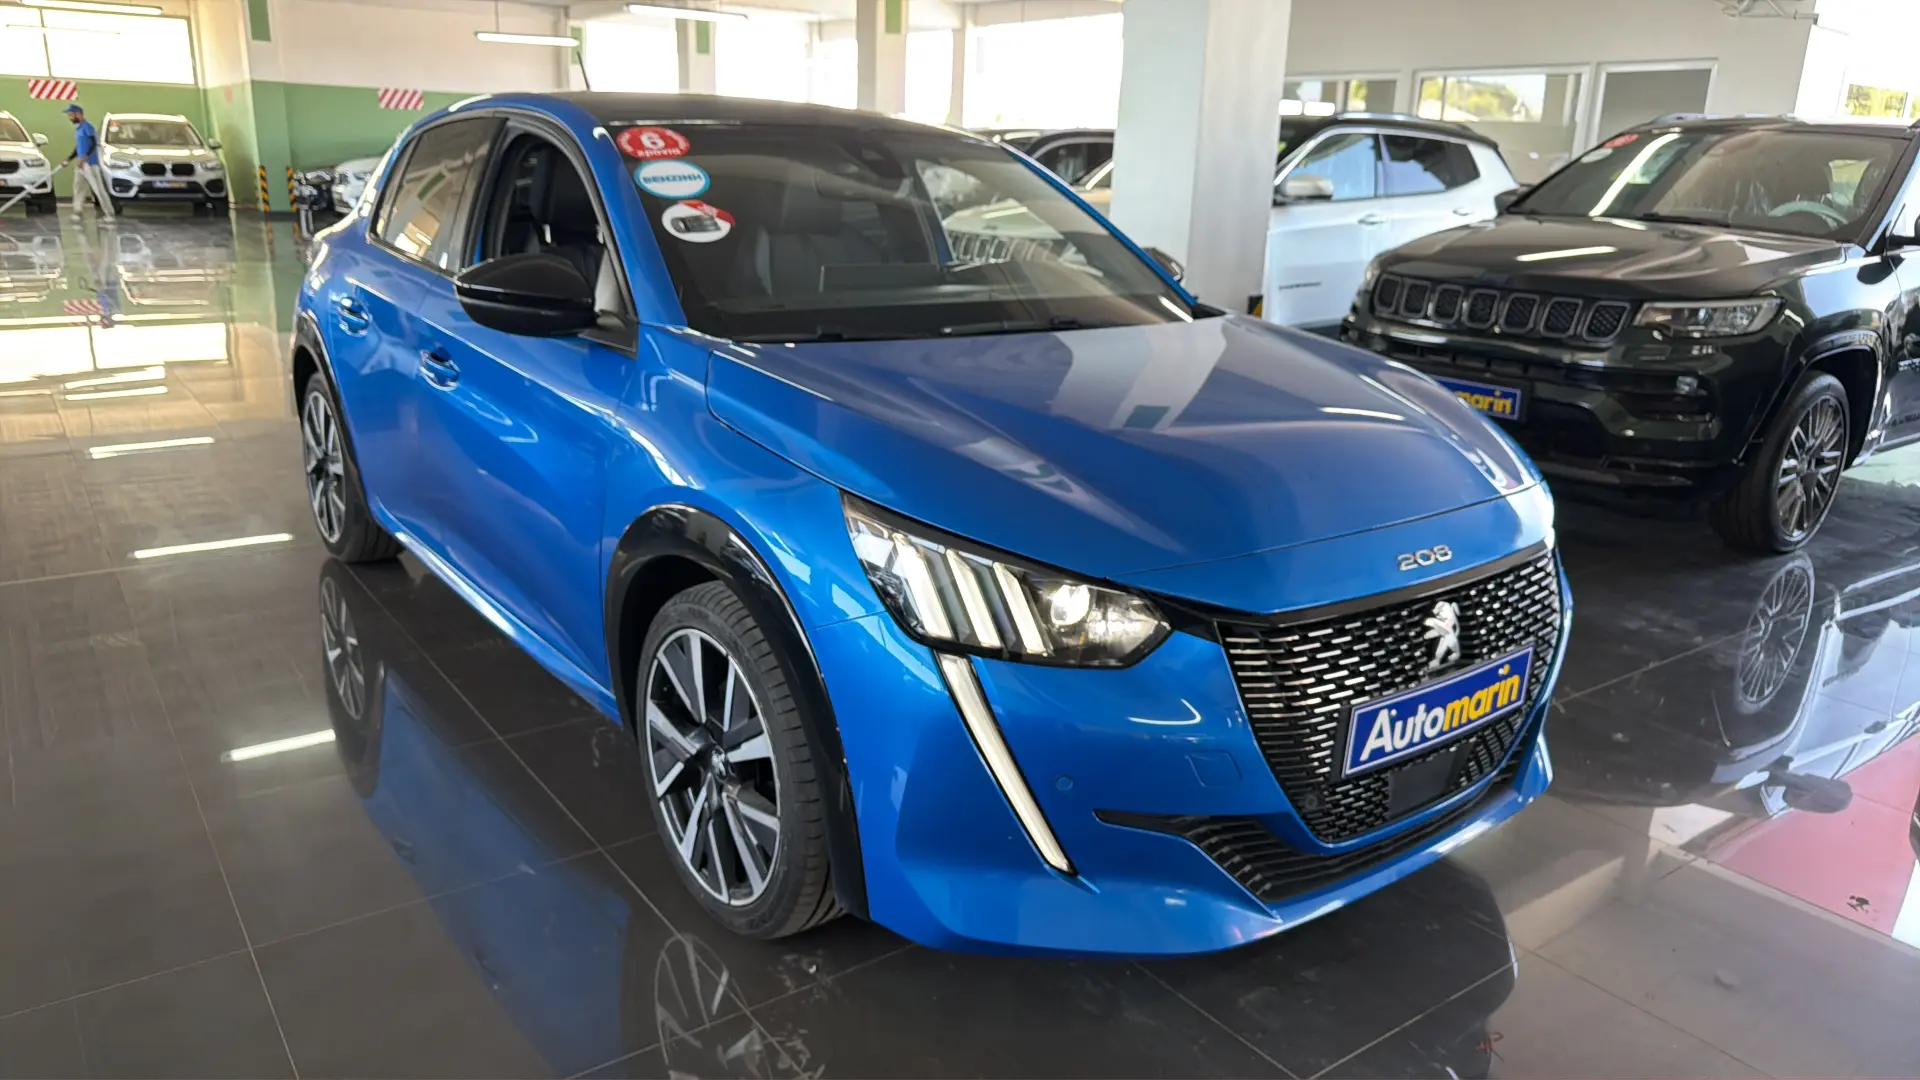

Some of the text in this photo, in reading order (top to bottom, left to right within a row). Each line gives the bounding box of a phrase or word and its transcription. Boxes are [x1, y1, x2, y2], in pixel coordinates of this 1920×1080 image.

[640, 131, 666, 150] 6
[1396, 543, 1453, 572] 208
[1359, 663, 1521, 762] Automarin
